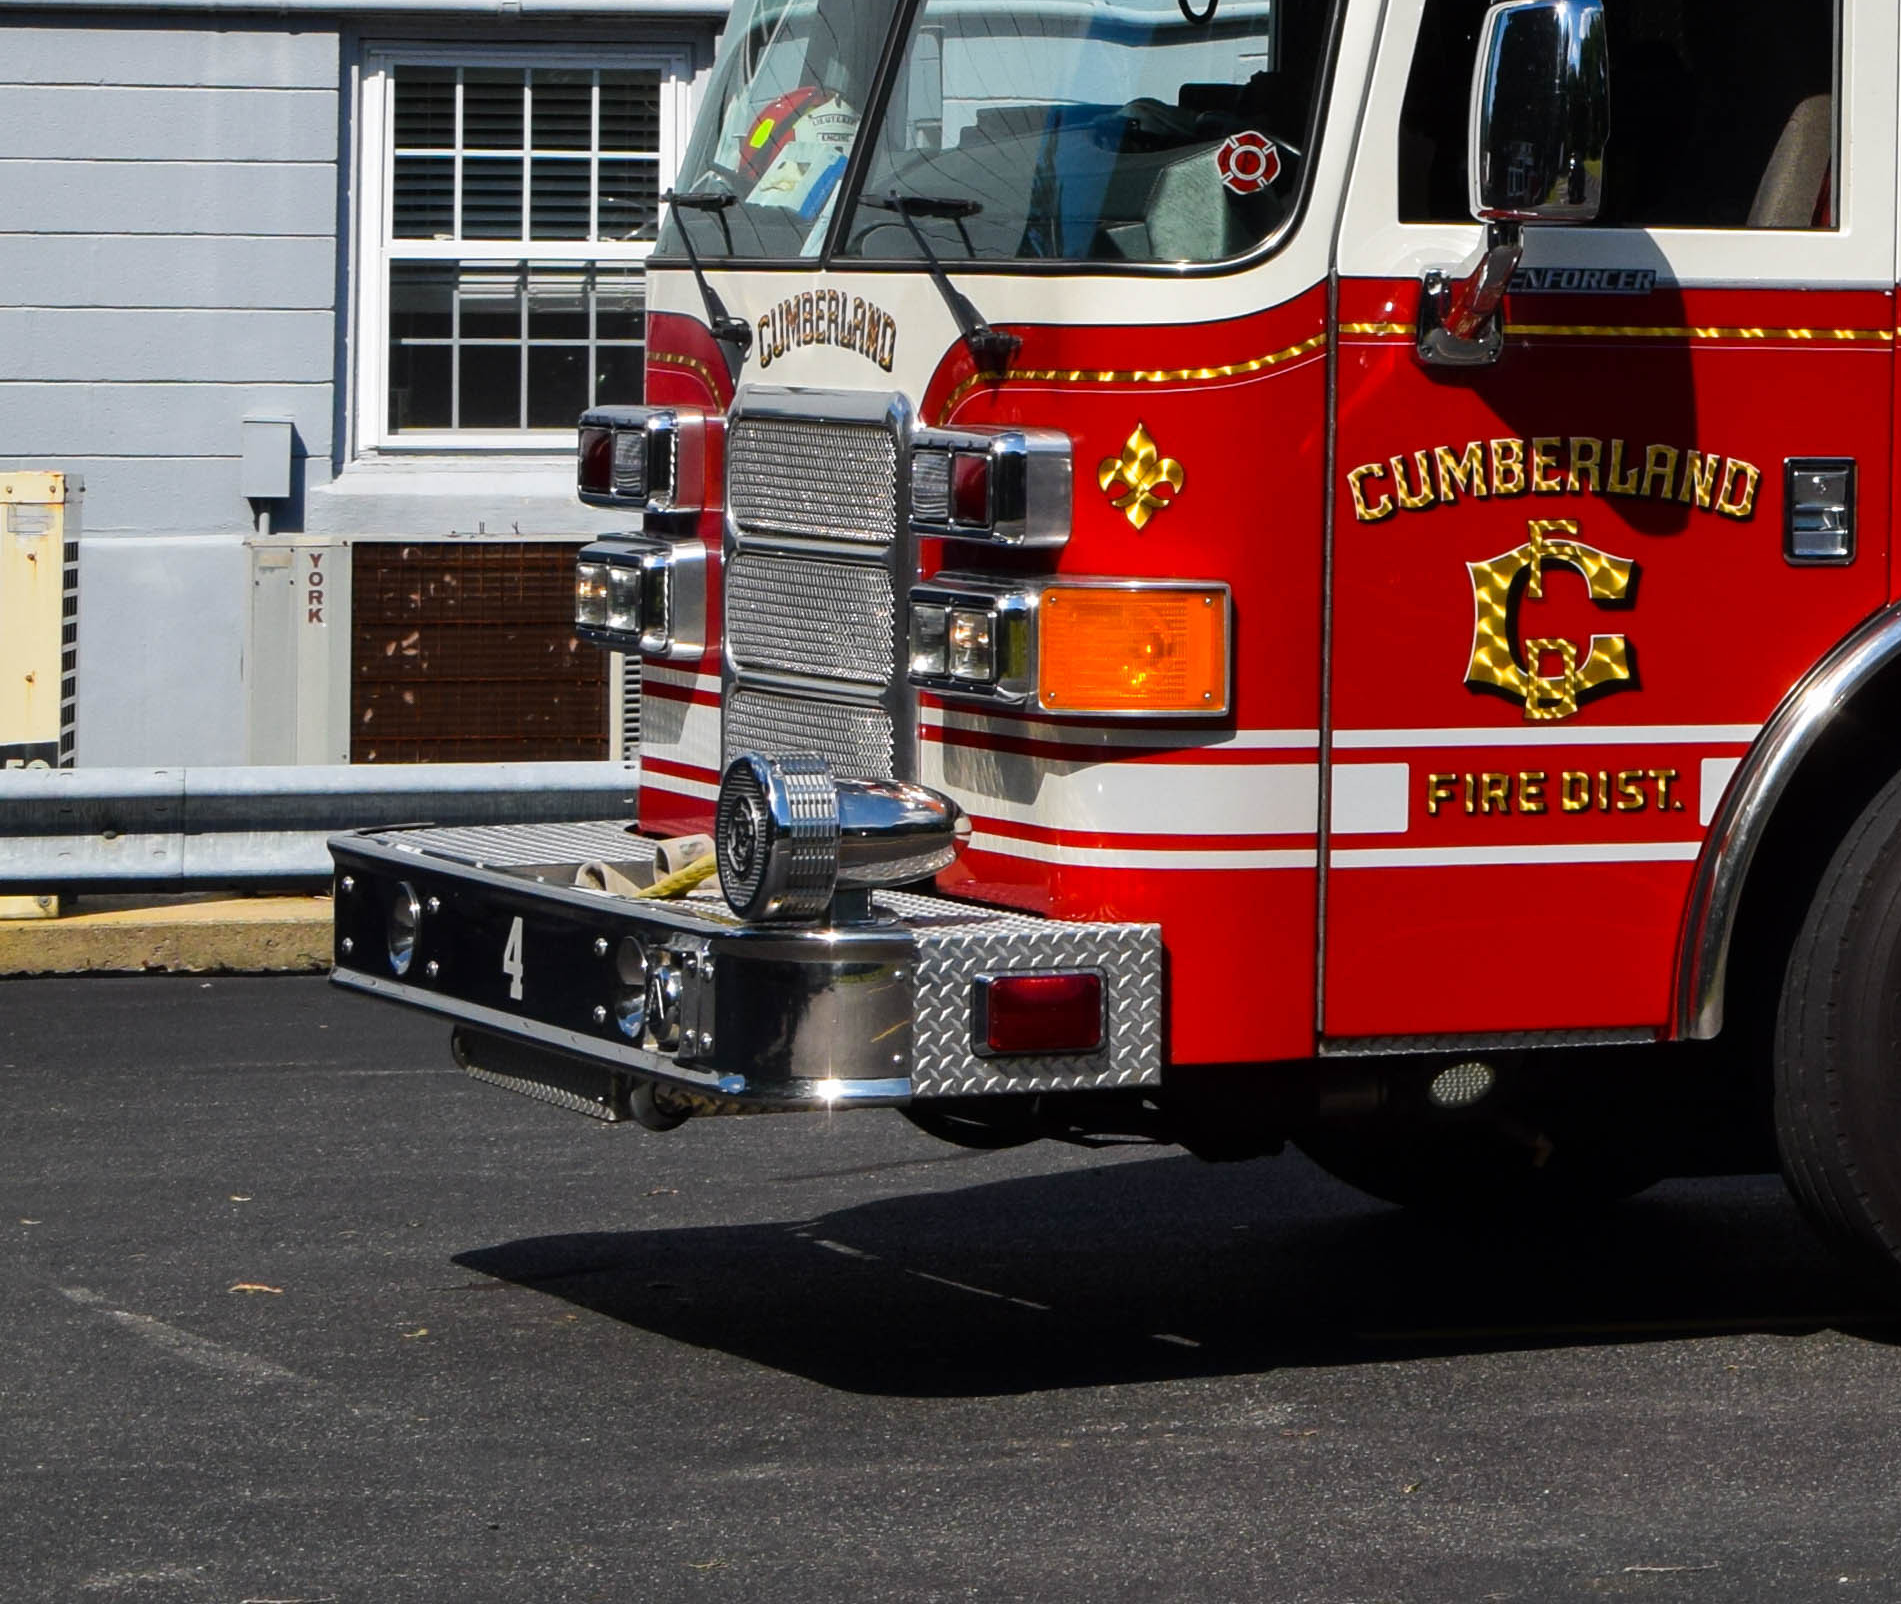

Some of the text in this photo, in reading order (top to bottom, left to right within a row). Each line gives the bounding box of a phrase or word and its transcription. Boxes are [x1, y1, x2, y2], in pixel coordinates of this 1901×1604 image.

[1508, 268, 1656, 291] ENFORCER
[757, 290, 897, 372] CUMBERLAND
[1346, 436, 1762, 521] CUMBERLAND
[308, 553, 325, 626] YORK
[1427, 768, 1685, 814] FIRE DIST.
[502, 916, 524, 1000] 4
